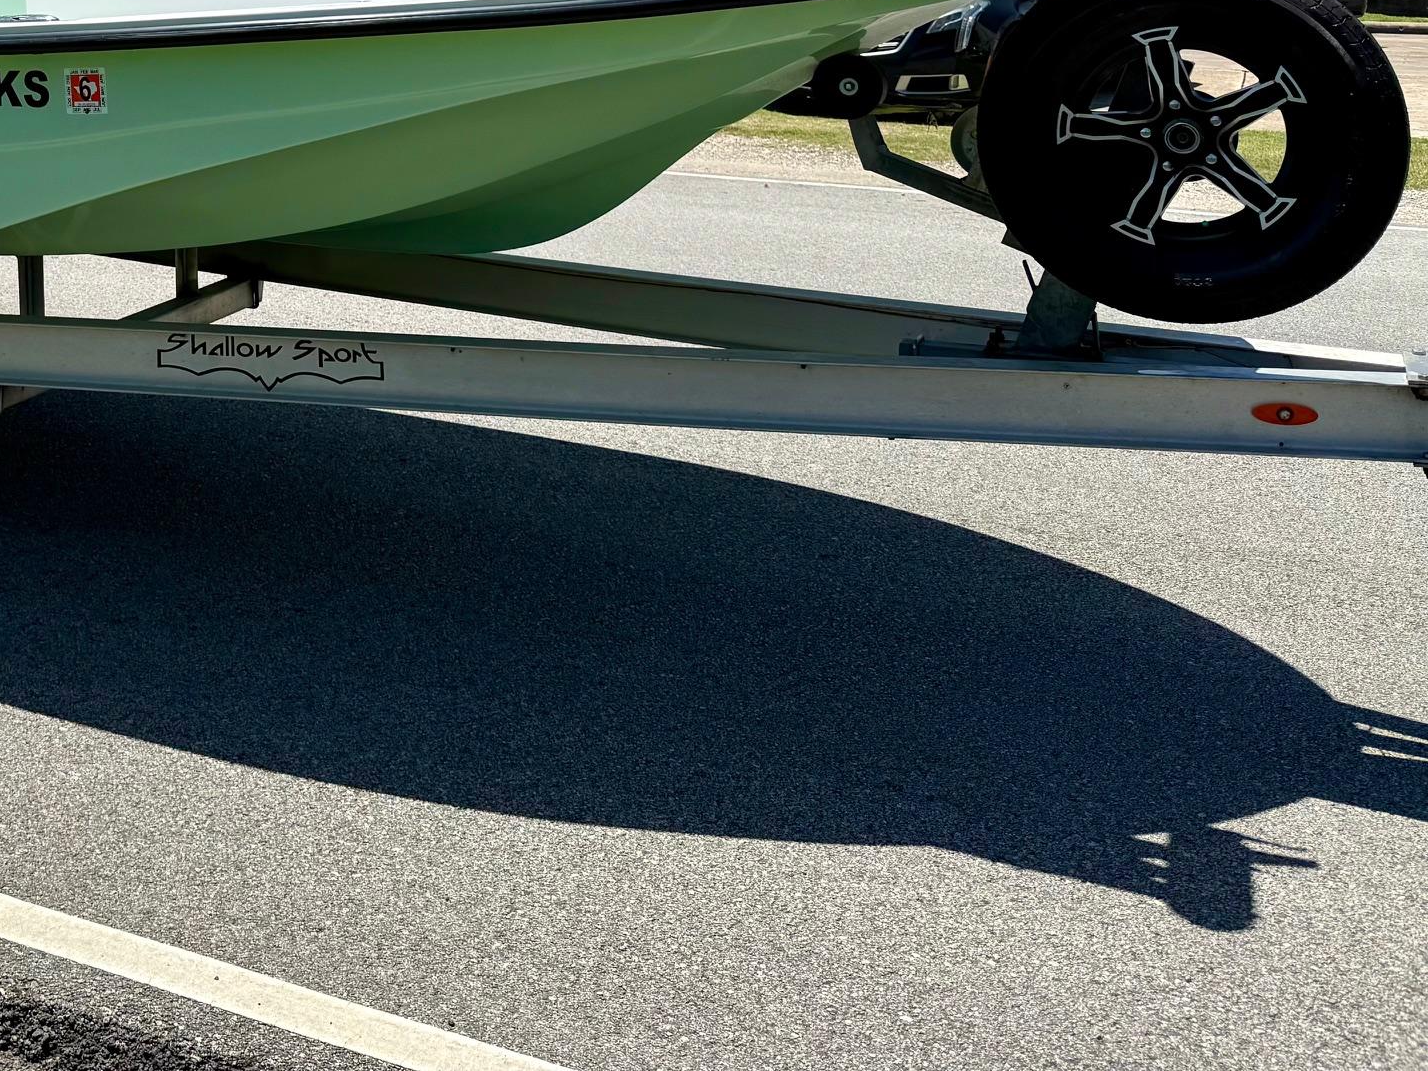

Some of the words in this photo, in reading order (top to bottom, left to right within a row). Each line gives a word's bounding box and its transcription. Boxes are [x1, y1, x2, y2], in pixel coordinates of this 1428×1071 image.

[79, 77, 92, 101] 6
[158, 333, 282, 358] Shallow
[292, 339, 384, 368] Sport
